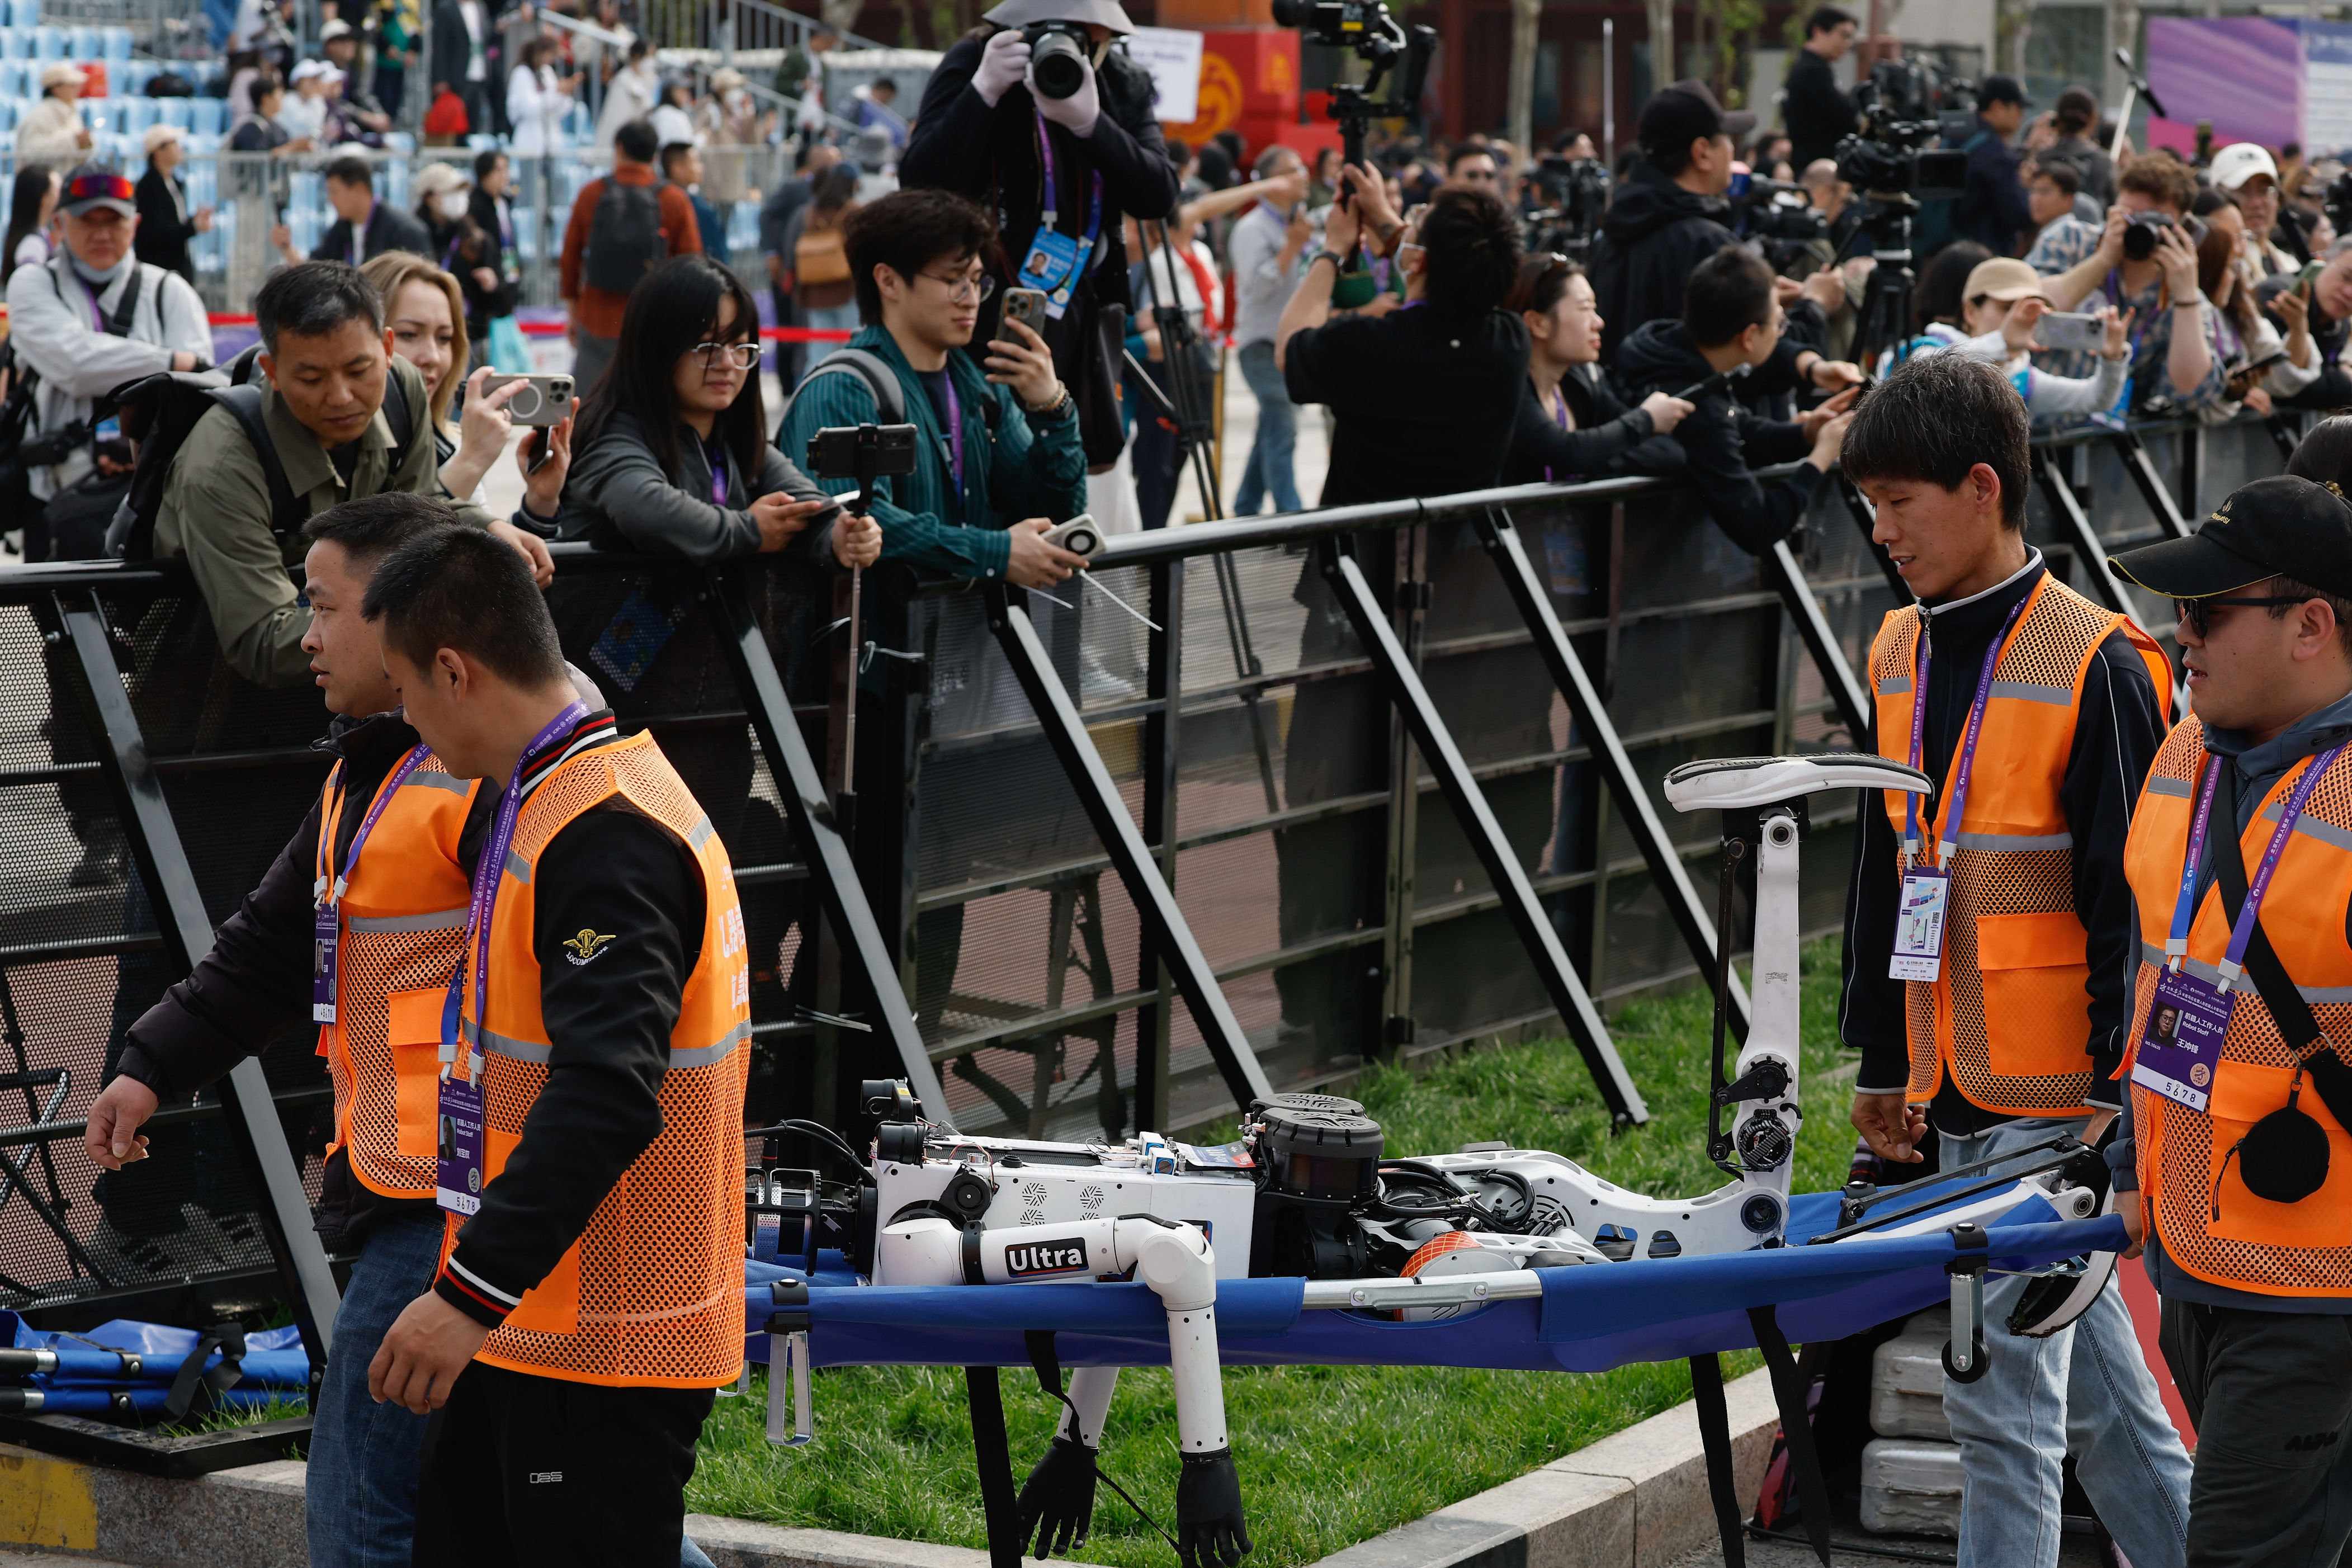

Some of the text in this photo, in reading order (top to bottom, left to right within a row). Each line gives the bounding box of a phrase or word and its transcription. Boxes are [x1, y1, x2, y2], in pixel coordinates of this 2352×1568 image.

[552, 726, 561, 735] ICBC
[391, 757, 415, 787] 北京机器人租赁
[2195, 799, 2207, 834] 北京机器人租赁
[2270, 818, 2289, 855] 北京机器人租赁
[2183, 1021, 2209, 1037] Robot Staff
[2184, 1012, 2224, 1035] 机器人工作人员
[2176, 1037, 2199, 1054] 王冲锋
[456, 1118, 481, 1132] 机器人工作人员
[1009, 1247, 1083, 1271] Ultra
